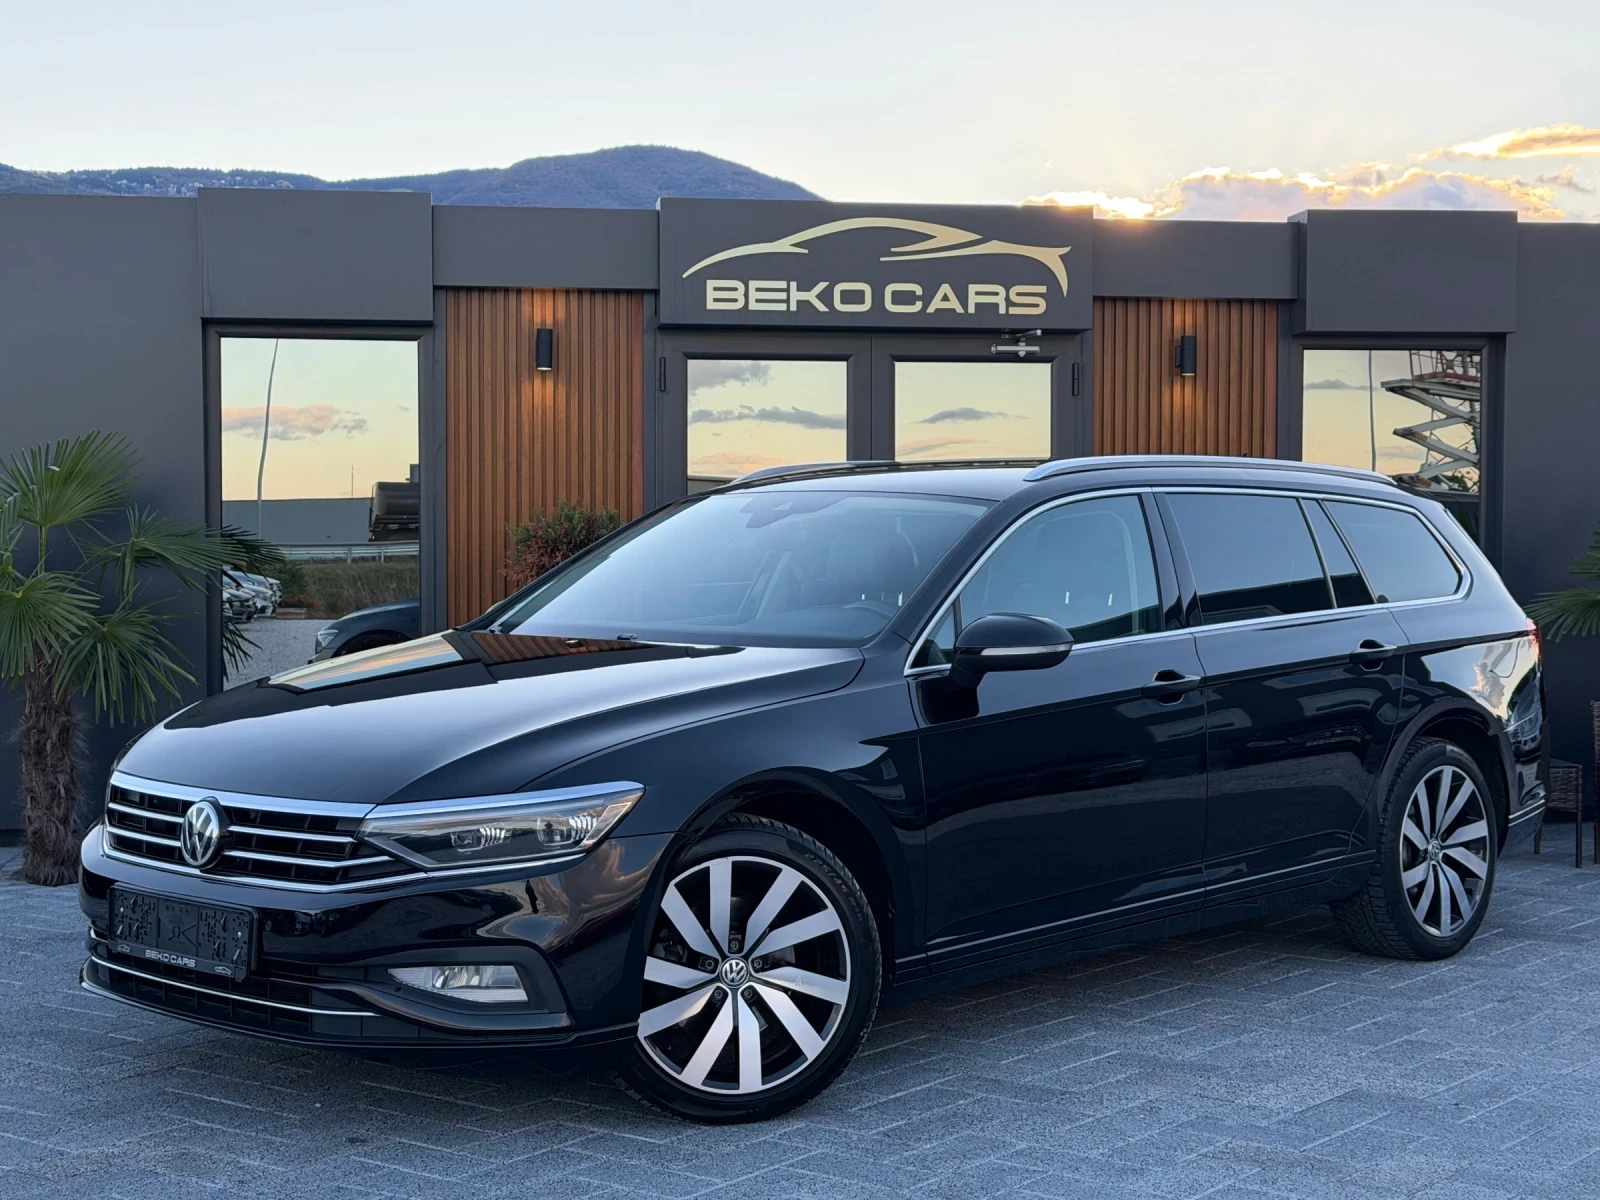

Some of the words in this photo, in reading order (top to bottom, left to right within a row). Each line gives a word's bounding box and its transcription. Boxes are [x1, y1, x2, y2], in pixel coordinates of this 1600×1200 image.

[706, 279, 872, 312] BEKO
[884, 283, 1047, 315] CARS
[145, 949, 170, 962] BEKO
[170, 955, 196, 968] CARS
